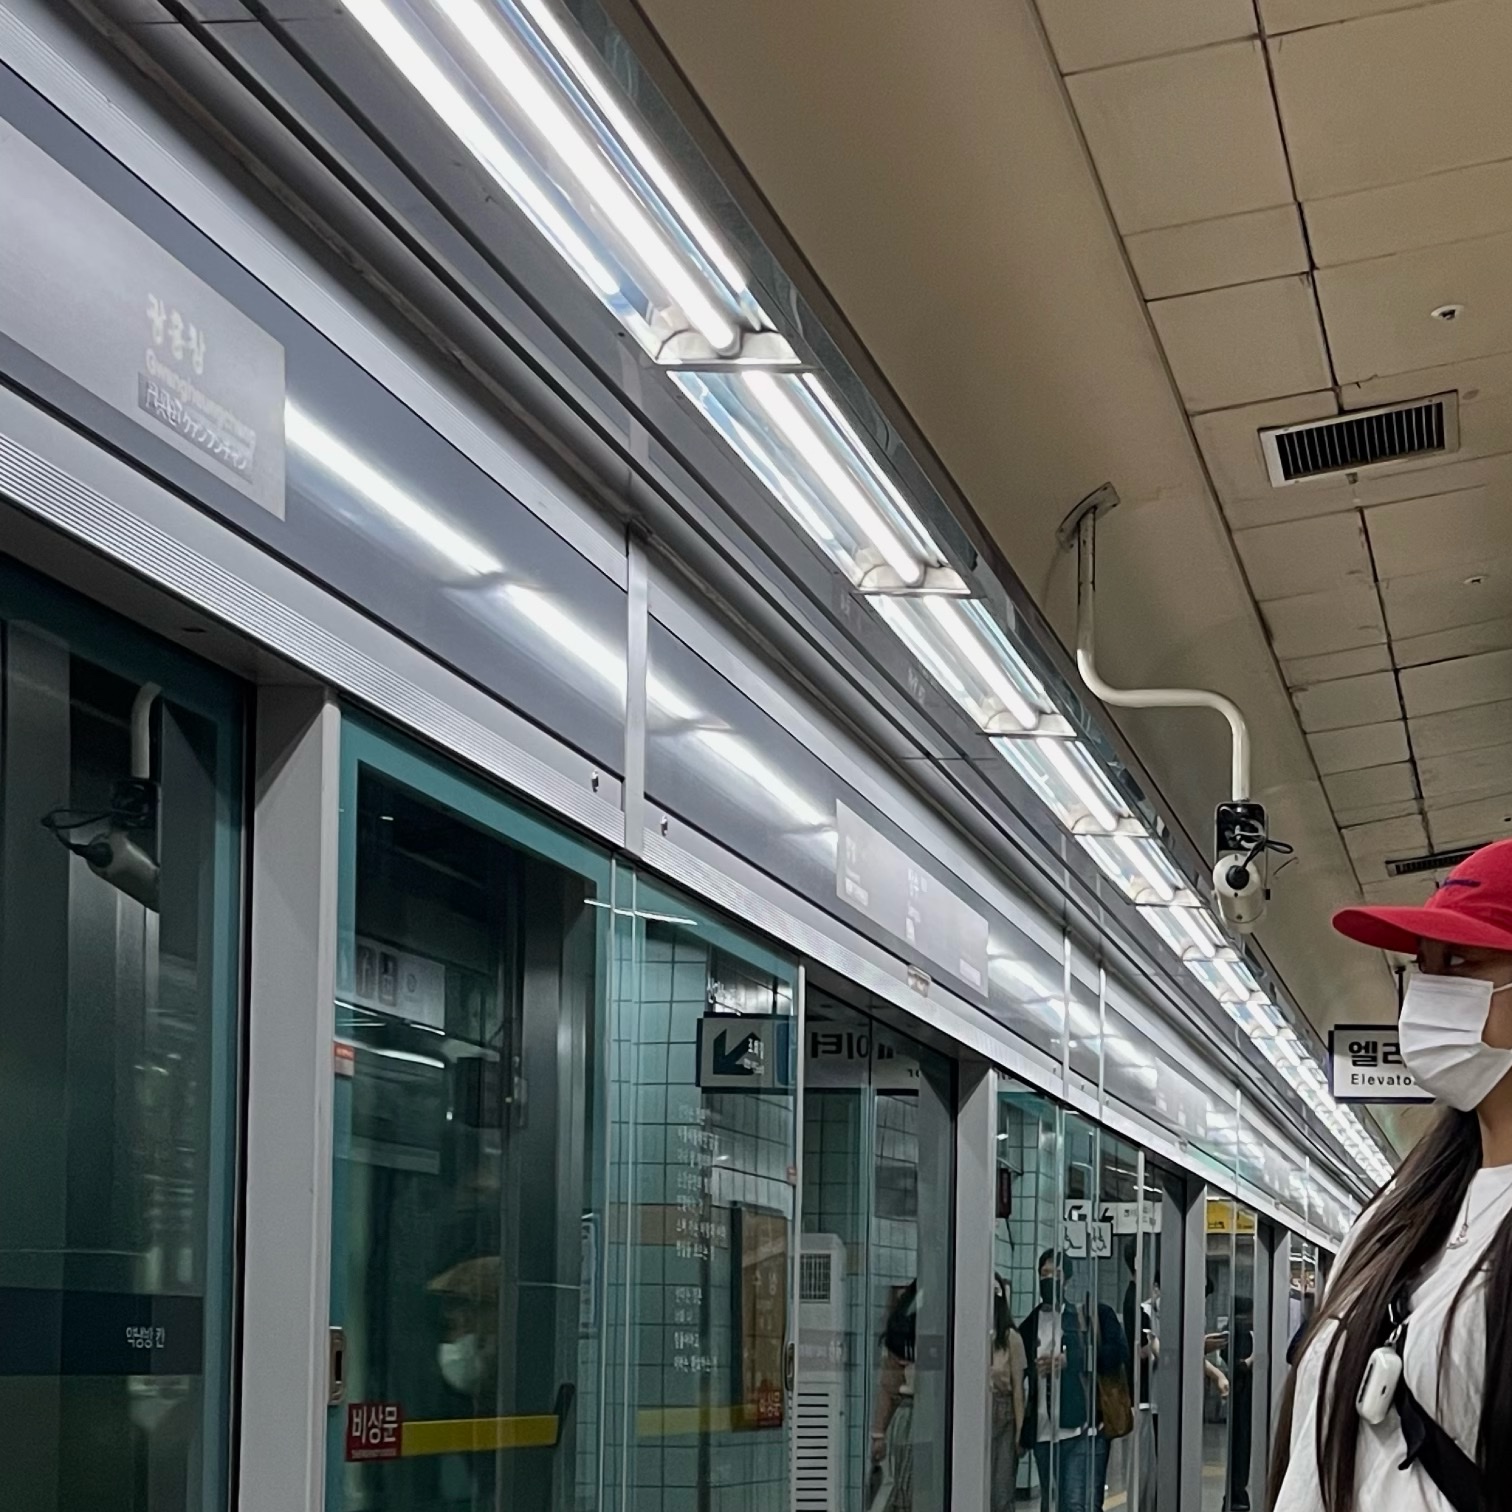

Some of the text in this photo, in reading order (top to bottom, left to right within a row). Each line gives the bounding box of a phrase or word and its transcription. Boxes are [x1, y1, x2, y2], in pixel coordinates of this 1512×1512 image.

[1350, 1073, 1414, 1086] Elevato
[155, 1326, 166, 1349] 칸
[352, 1404, 399, 1446] 비상문
